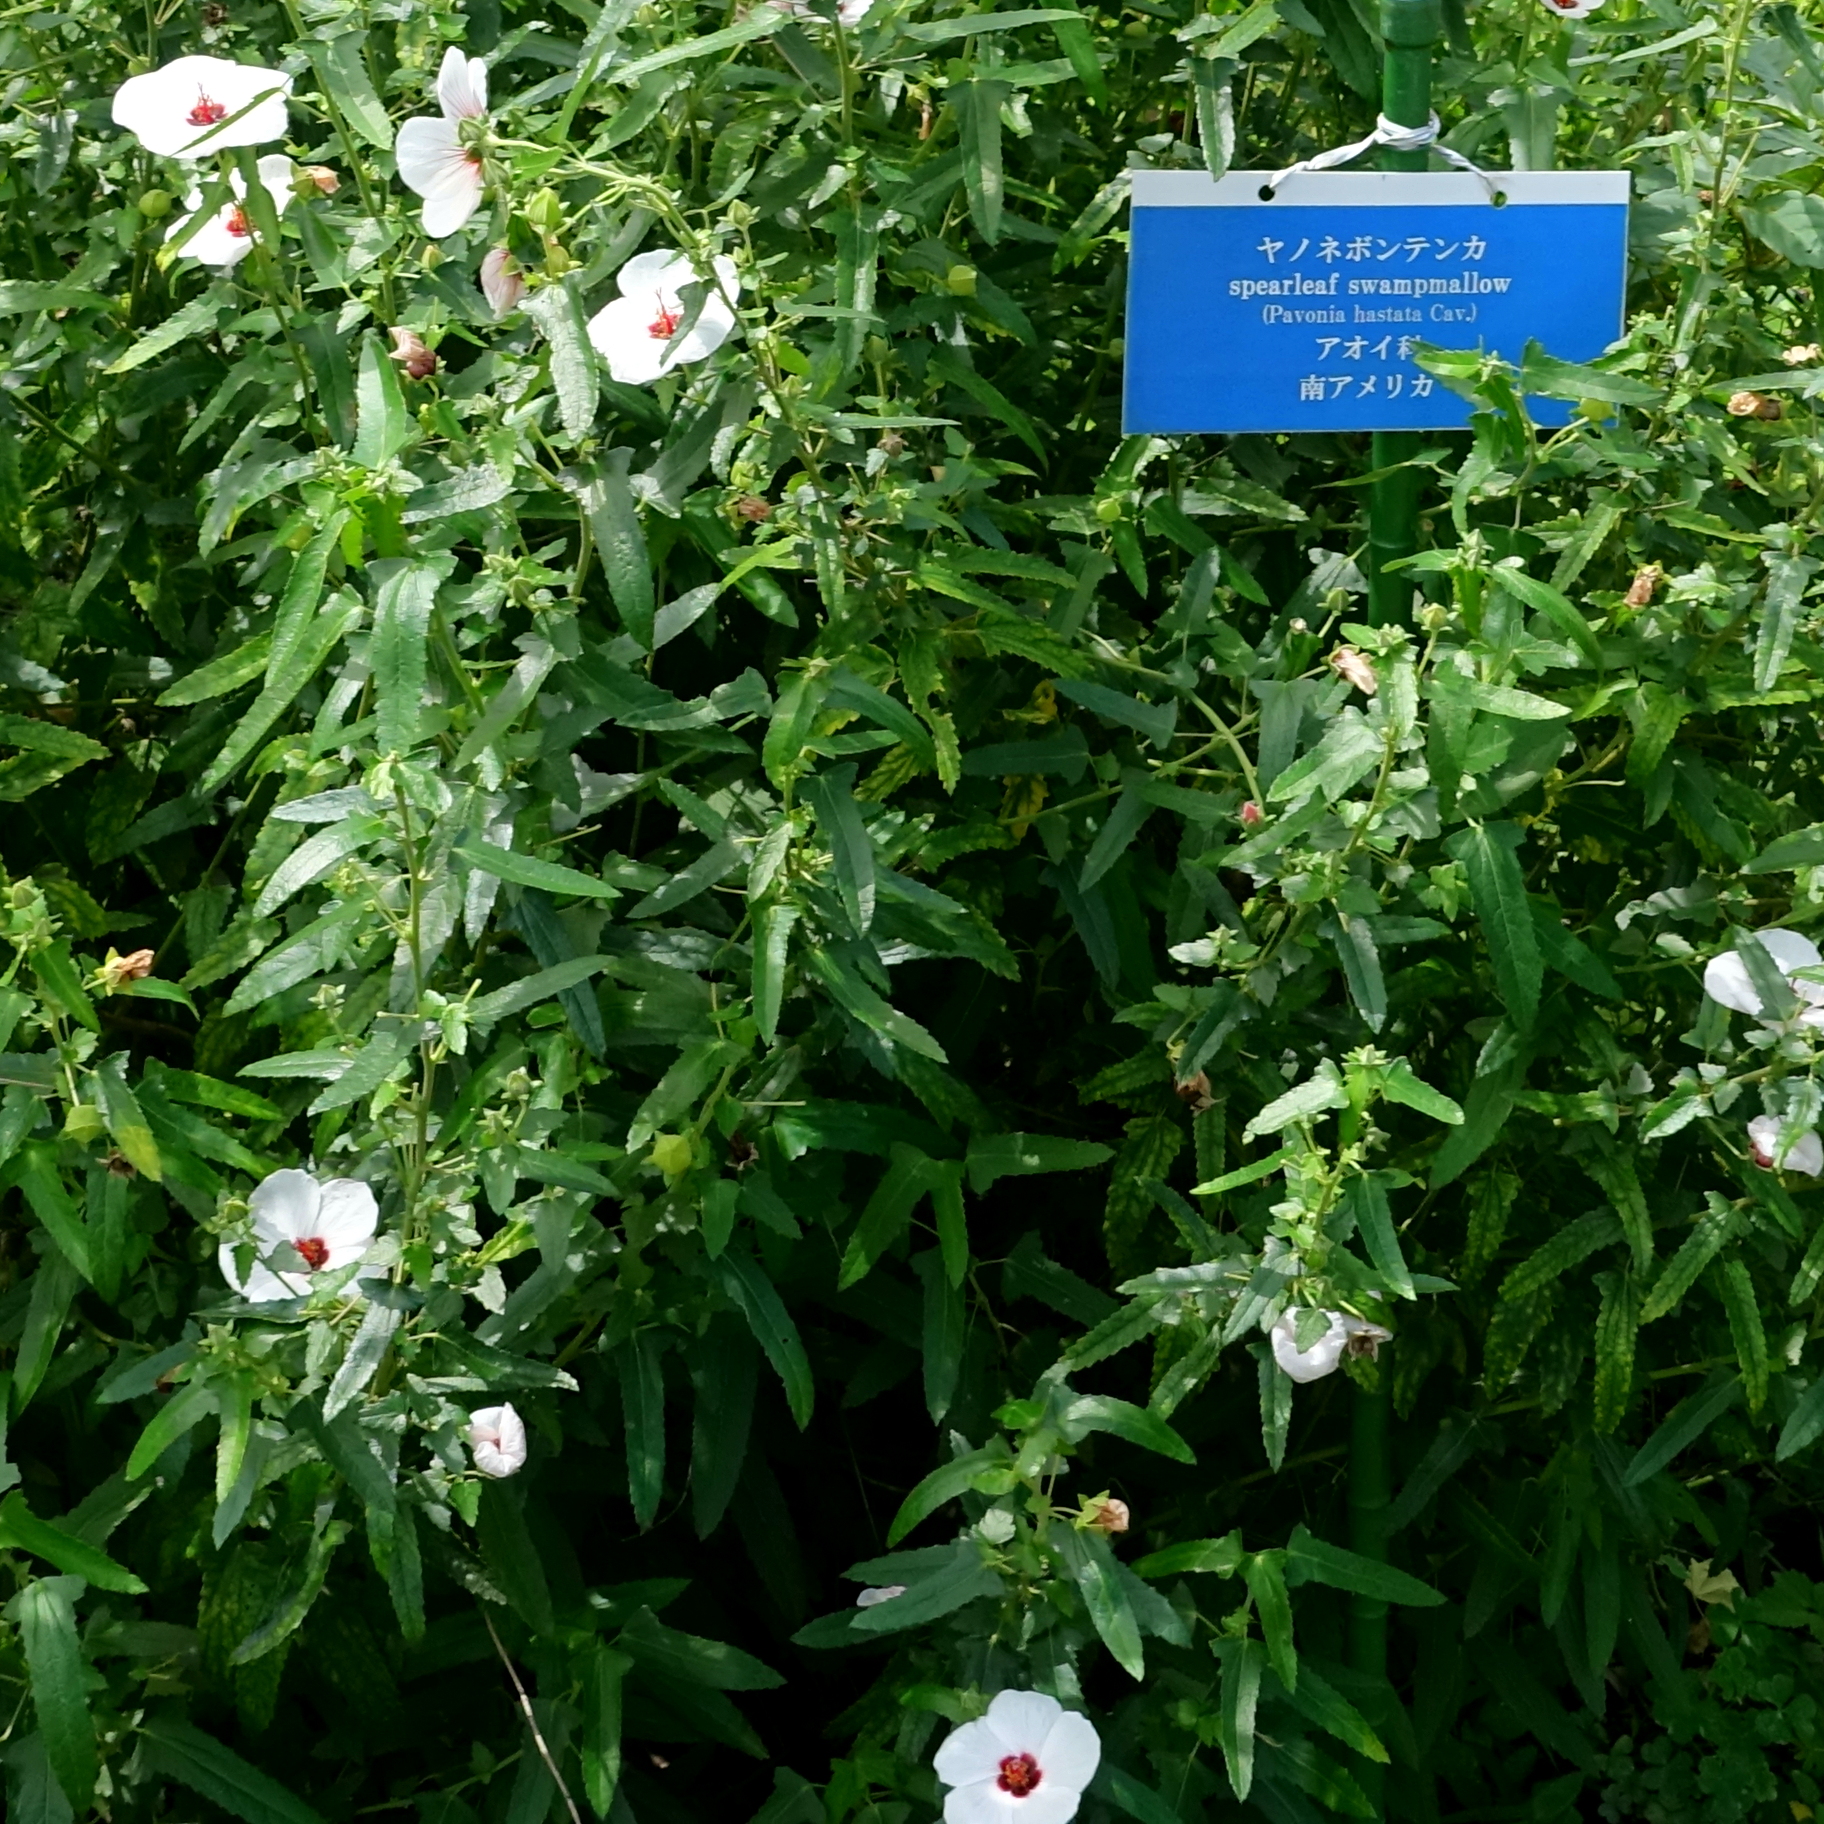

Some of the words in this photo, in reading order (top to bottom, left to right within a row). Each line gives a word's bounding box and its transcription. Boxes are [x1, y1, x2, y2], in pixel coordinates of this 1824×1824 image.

[1256, 235, 1487, 264] ヤノネボンテンカ
[1228, 272, 1339, 299] spearleaf
[1347, 272, 1512, 298] swampmallow
[1262, 304, 1346, 325] (Pavonia
[1352, 304, 1423, 324] hastata
[1429, 303, 1477, 324] Cav.)
[1299, 373, 1434, 402] 南アメリカ
